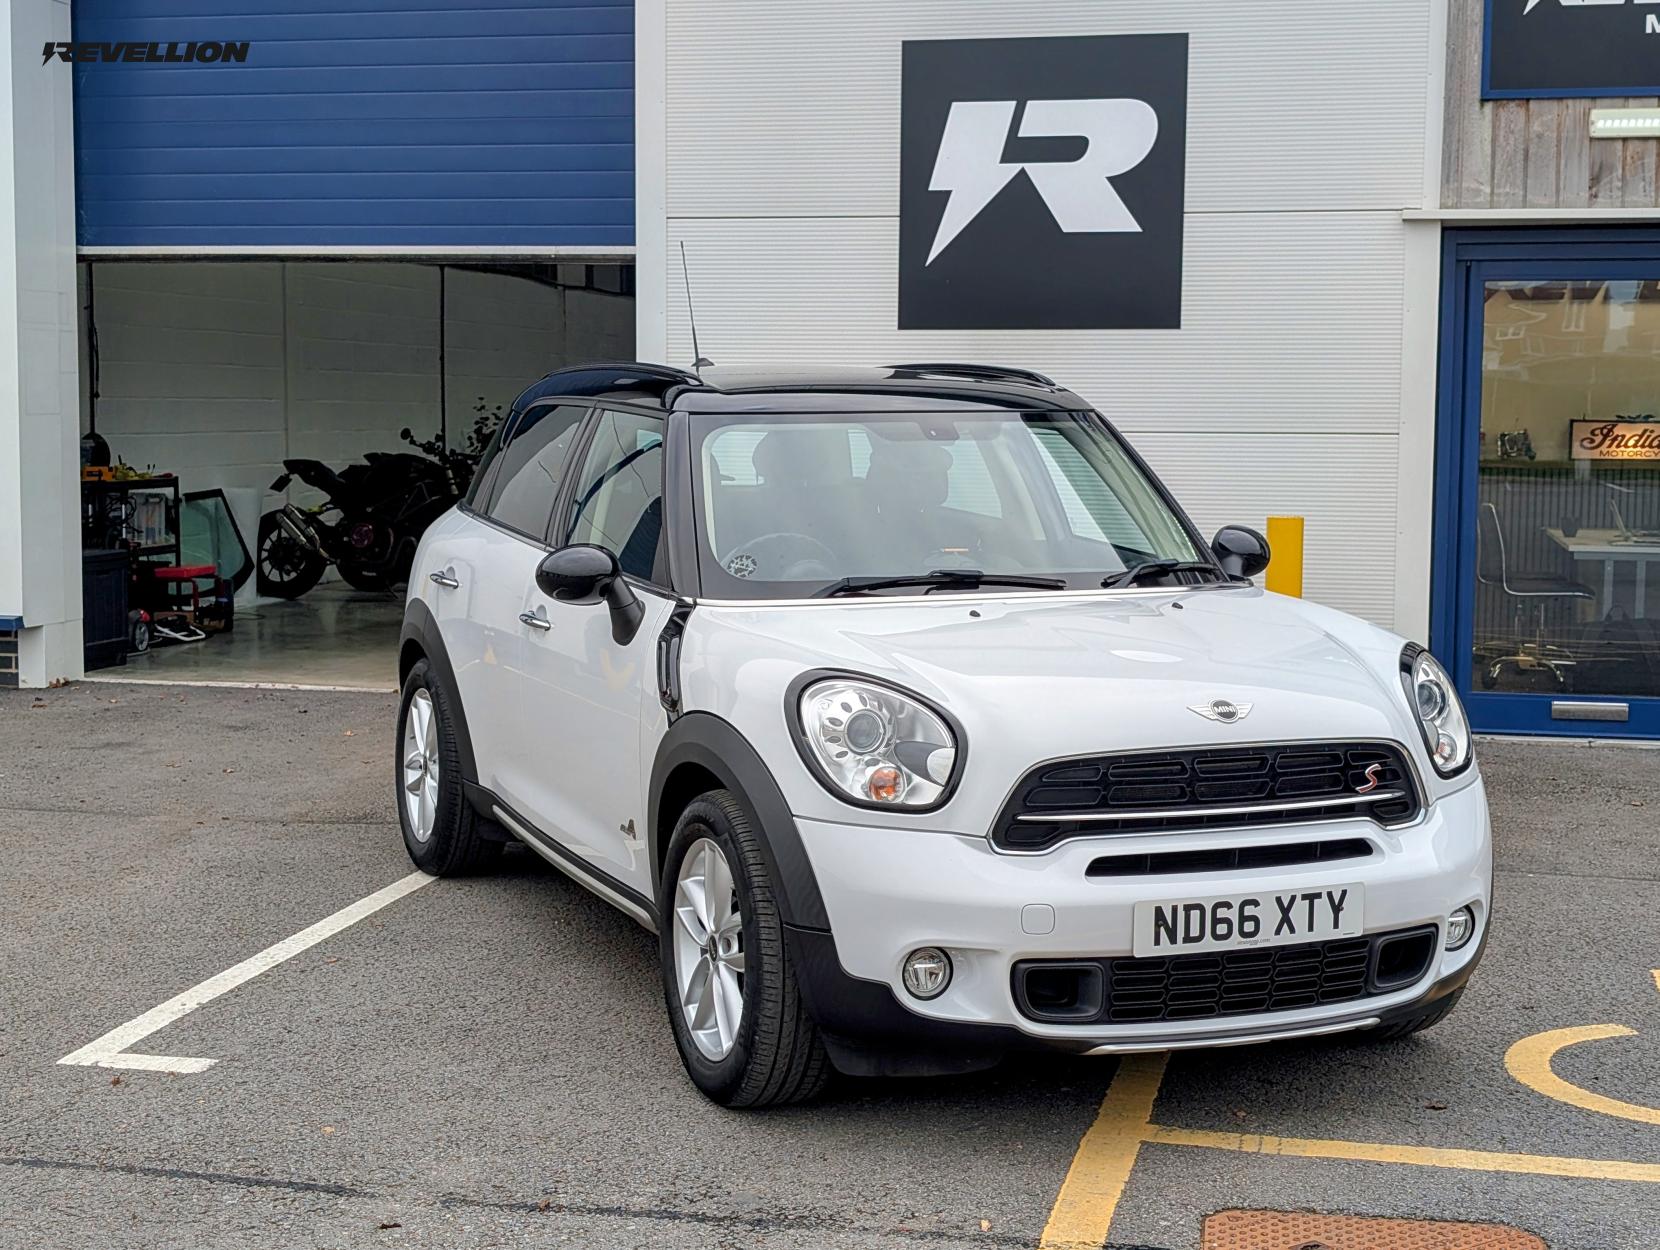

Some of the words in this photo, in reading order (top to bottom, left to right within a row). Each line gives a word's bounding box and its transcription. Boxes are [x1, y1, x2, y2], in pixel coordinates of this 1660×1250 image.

[1213, 705, 1237, 714] MINI
[1355, 763, 1382, 794] S
[1153, 898, 1261, 946] ND66
[1274, 888, 1348, 936] XTY
